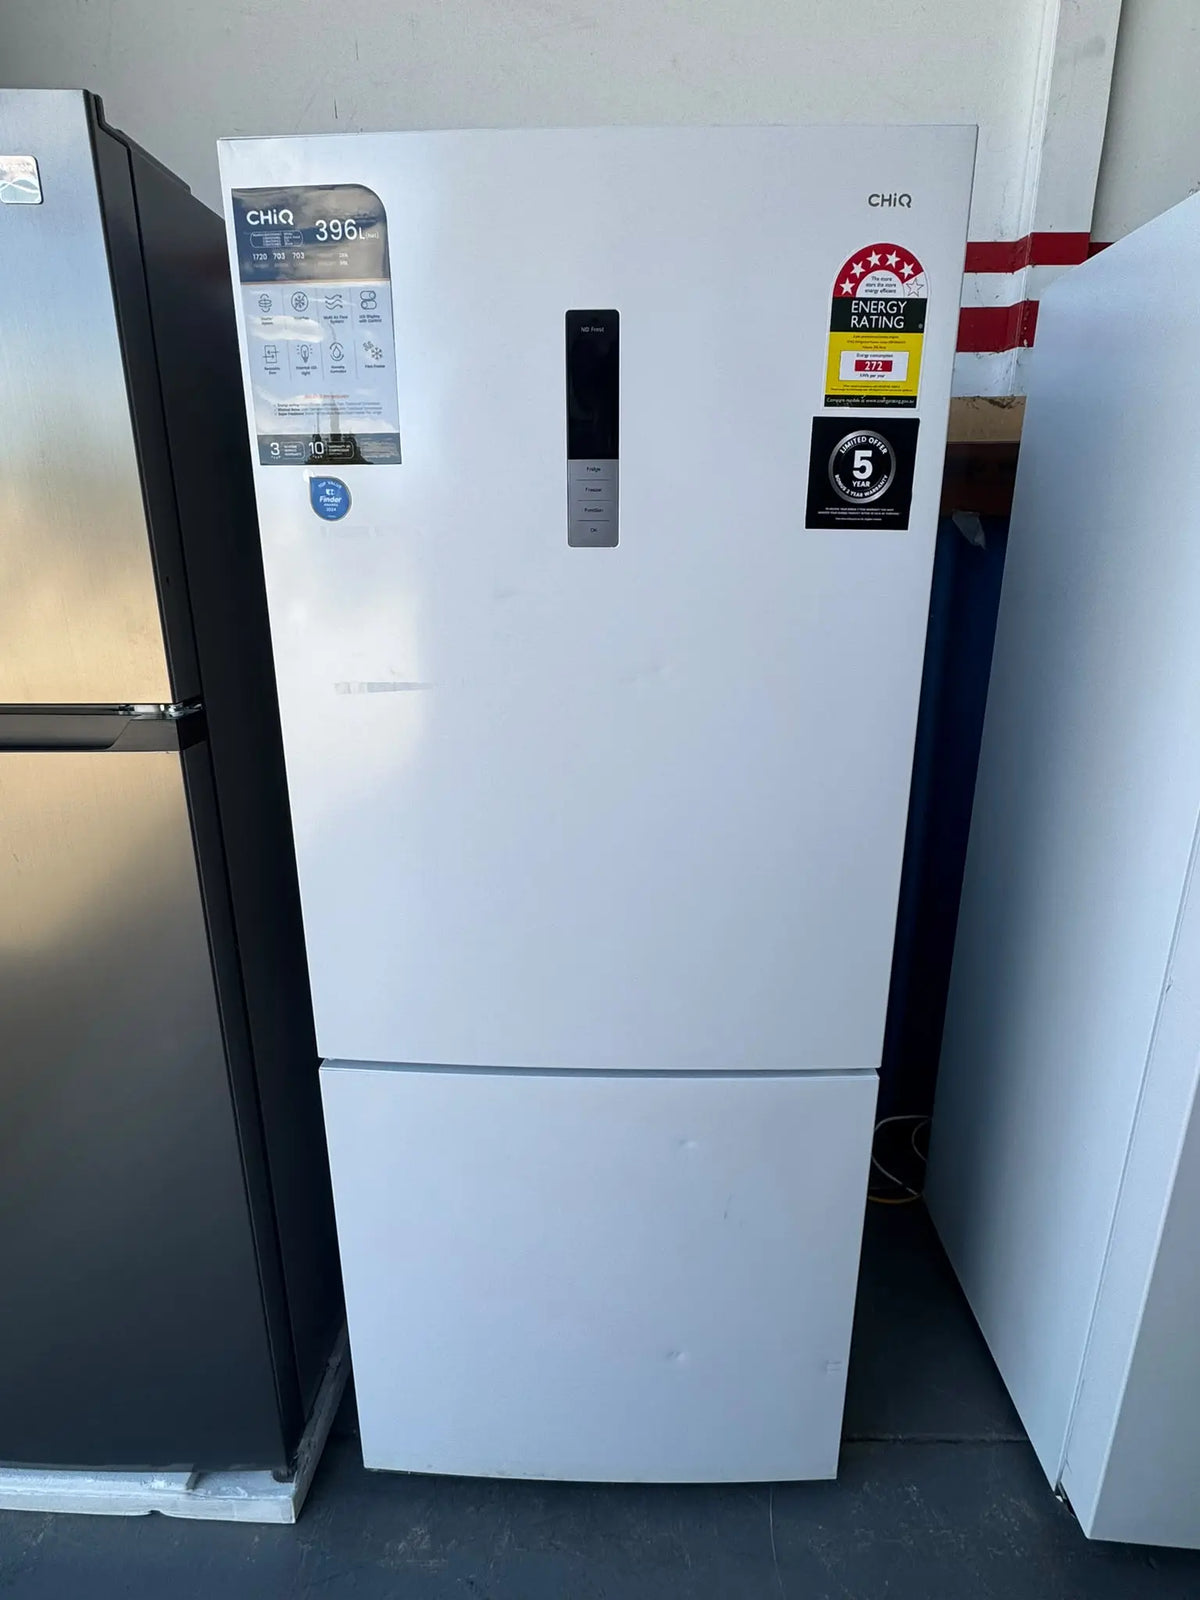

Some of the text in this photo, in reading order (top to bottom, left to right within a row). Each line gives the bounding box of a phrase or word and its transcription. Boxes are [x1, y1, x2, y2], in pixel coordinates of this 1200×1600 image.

[868, 193, 912, 208] CHiQ
[246, 209, 294, 226] CHiQ
[273, 252, 286, 260] 703
[292, 251, 305, 259] 703
[851, 300, 907, 314] ENERGY
[850, 315, 905, 329] RATING
[864, 361, 883, 371] 272
[270, 442, 280, 456] 3
[308, 441, 325, 455] 10
[839, 436, 888, 454] LIMITED OFFER
[852, 449, 873, 480] 5
[852, 480, 871, 488] YEAR
[864, 474, 888, 497] WARRANTY
